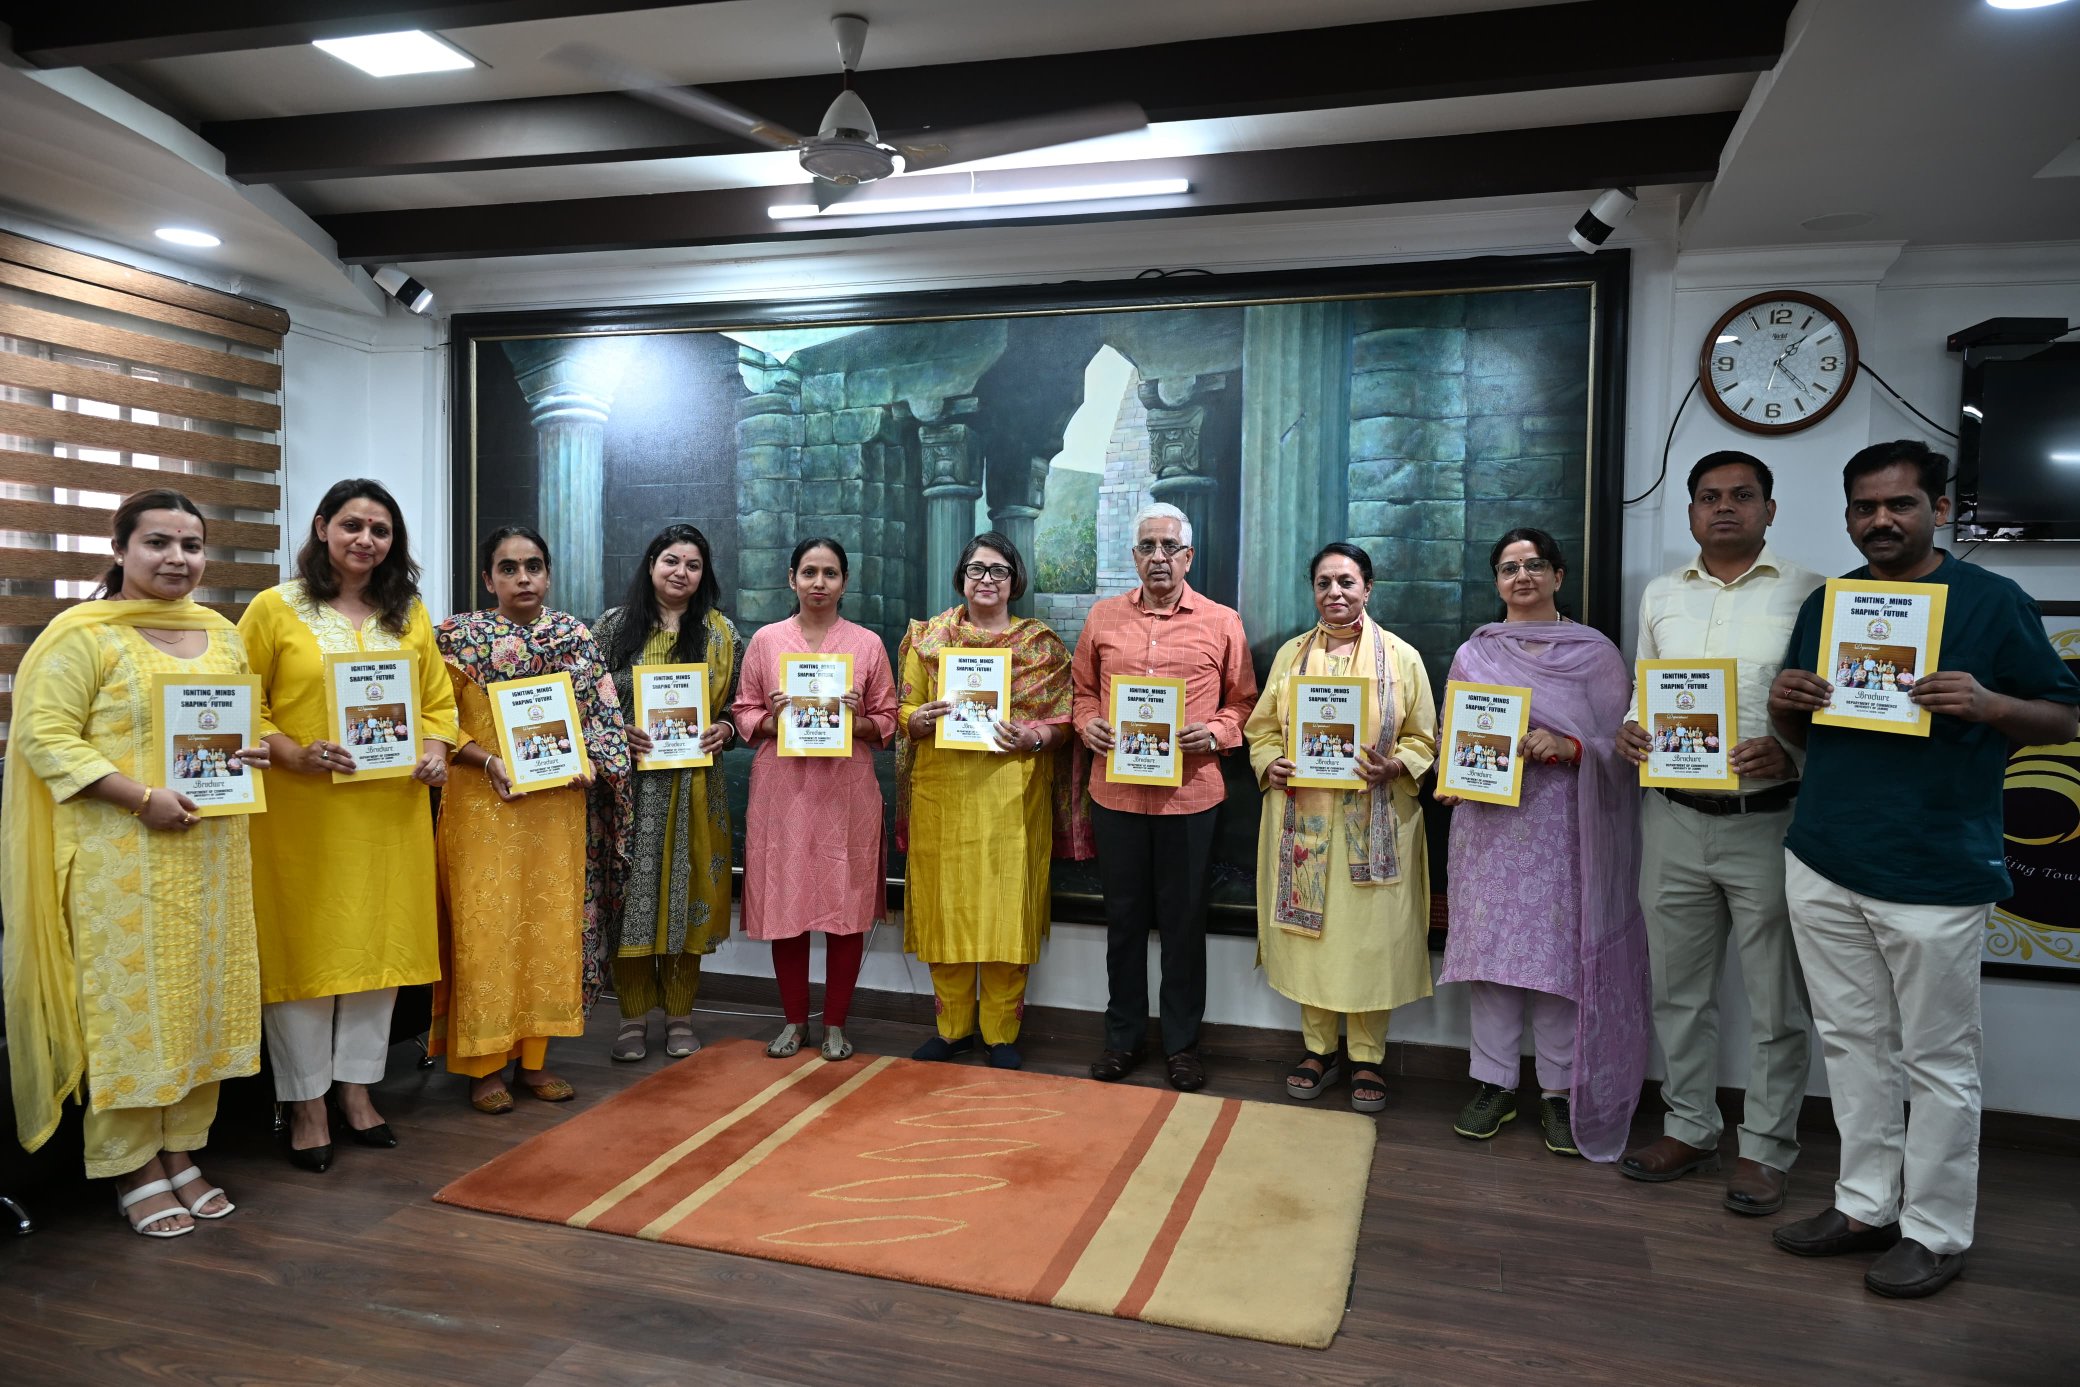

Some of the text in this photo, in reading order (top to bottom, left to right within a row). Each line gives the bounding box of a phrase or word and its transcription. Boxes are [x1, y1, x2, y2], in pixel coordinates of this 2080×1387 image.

[1770, 310, 1792, 324] 12
[1718, 357, 1734, 371] 9
[1820, 357, 1837, 371] 3
[1766, 403, 1781, 418] 6
[1880, 603, 1892, 612] for
[1855, 691, 1889, 701] Brochure
[536, 758, 558, 767] Brochure
[1467, 770, 1492, 778] Brochure
[193, 780, 224, 788] Brochure
